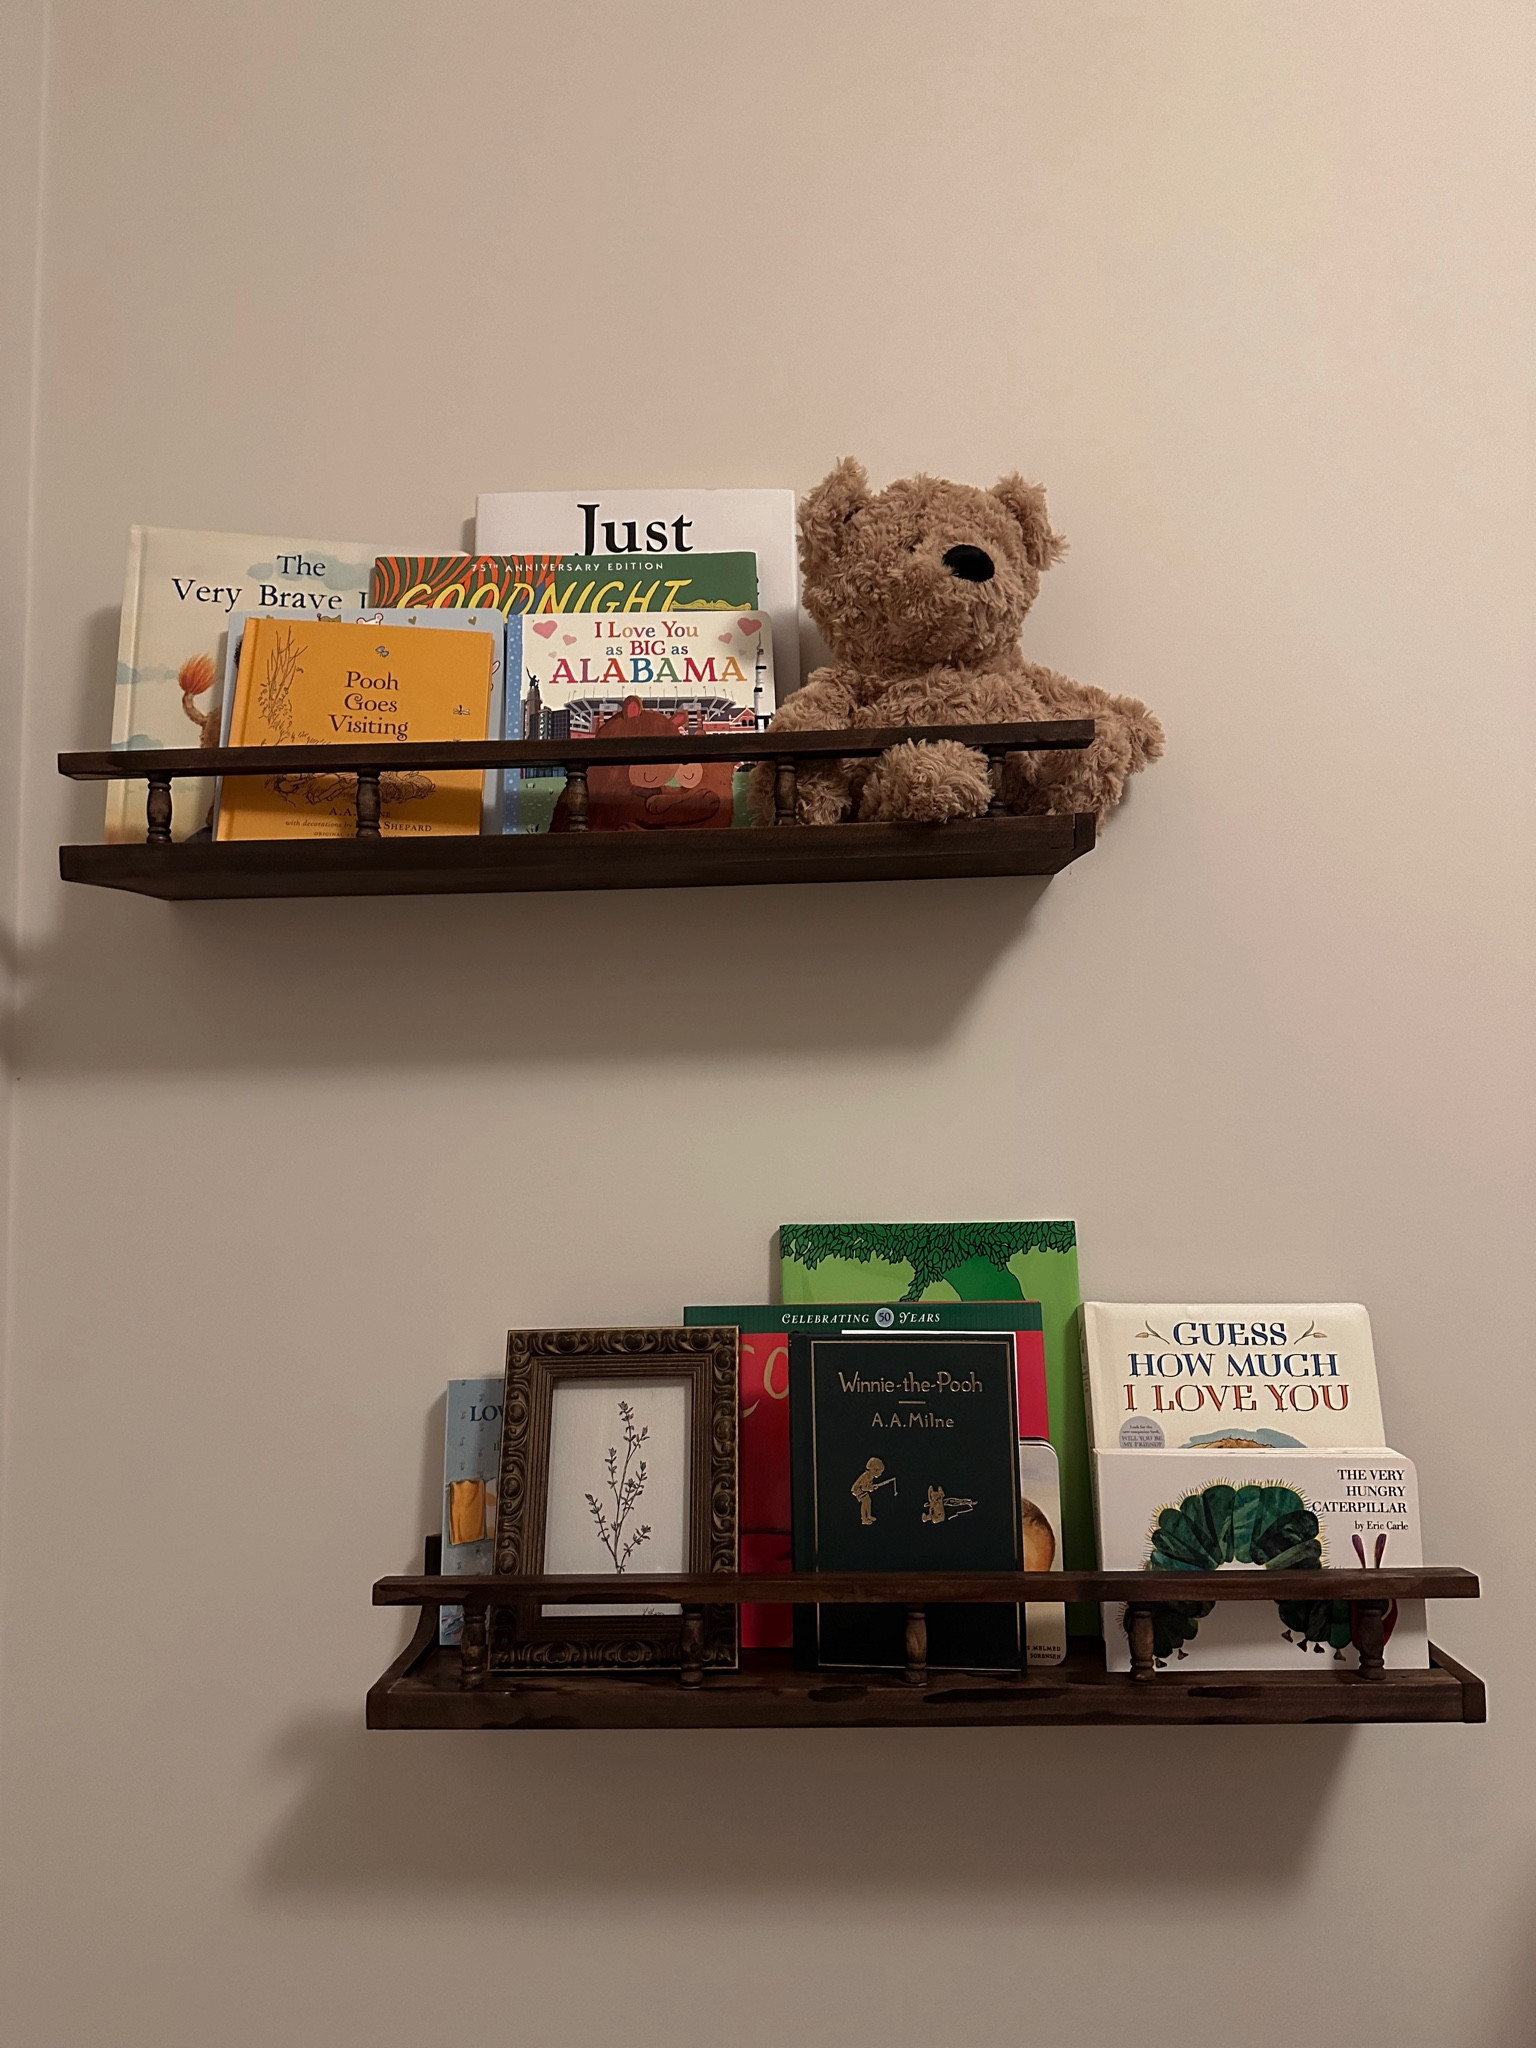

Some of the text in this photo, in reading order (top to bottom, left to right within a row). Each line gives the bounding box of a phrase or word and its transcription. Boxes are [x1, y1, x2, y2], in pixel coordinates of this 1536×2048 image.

[575, 504, 693, 556] Just
[276, 554, 326, 577] The
[471, 561, 664, 572] 75TH ANNIVERSARY EDITION
[171, 578, 242, 612] Very
[258, 584, 342, 610] Brave
[397, 579, 692, 616] GOODNIGHT
[594, 620, 699, 638] I Love You
[605, 640, 688, 656] as BIG as
[549, 656, 747, 685] ALABAMA
[344, 671, 399, 692] Pooh
[343, 693, 398, 713] Goes
[328, 713, 409, 741] Visiting
[302, 820, 342, 829] decorations
[781, 1313, 870, 1325] CELEBRATING
[878, 1312, 891, 1323] 50
[1172, 1321, 1288, 1347] GUESS
[1127, 1352, 1341, 1379] HOW MUCH
[838, 1371, 983, 1393] Winnie-the-Pooh
[1123, 1383, 1350, 1414] I LOVE YOU
[1337, 1469, 1405, 1480] THE VERY
[1346, 1485, 1406, 1497] HUNGRY
[1312, 1501, 1407, 1513] CATERPILLAR
[1354, 1521, 1409, 1531] by Eric Carle
